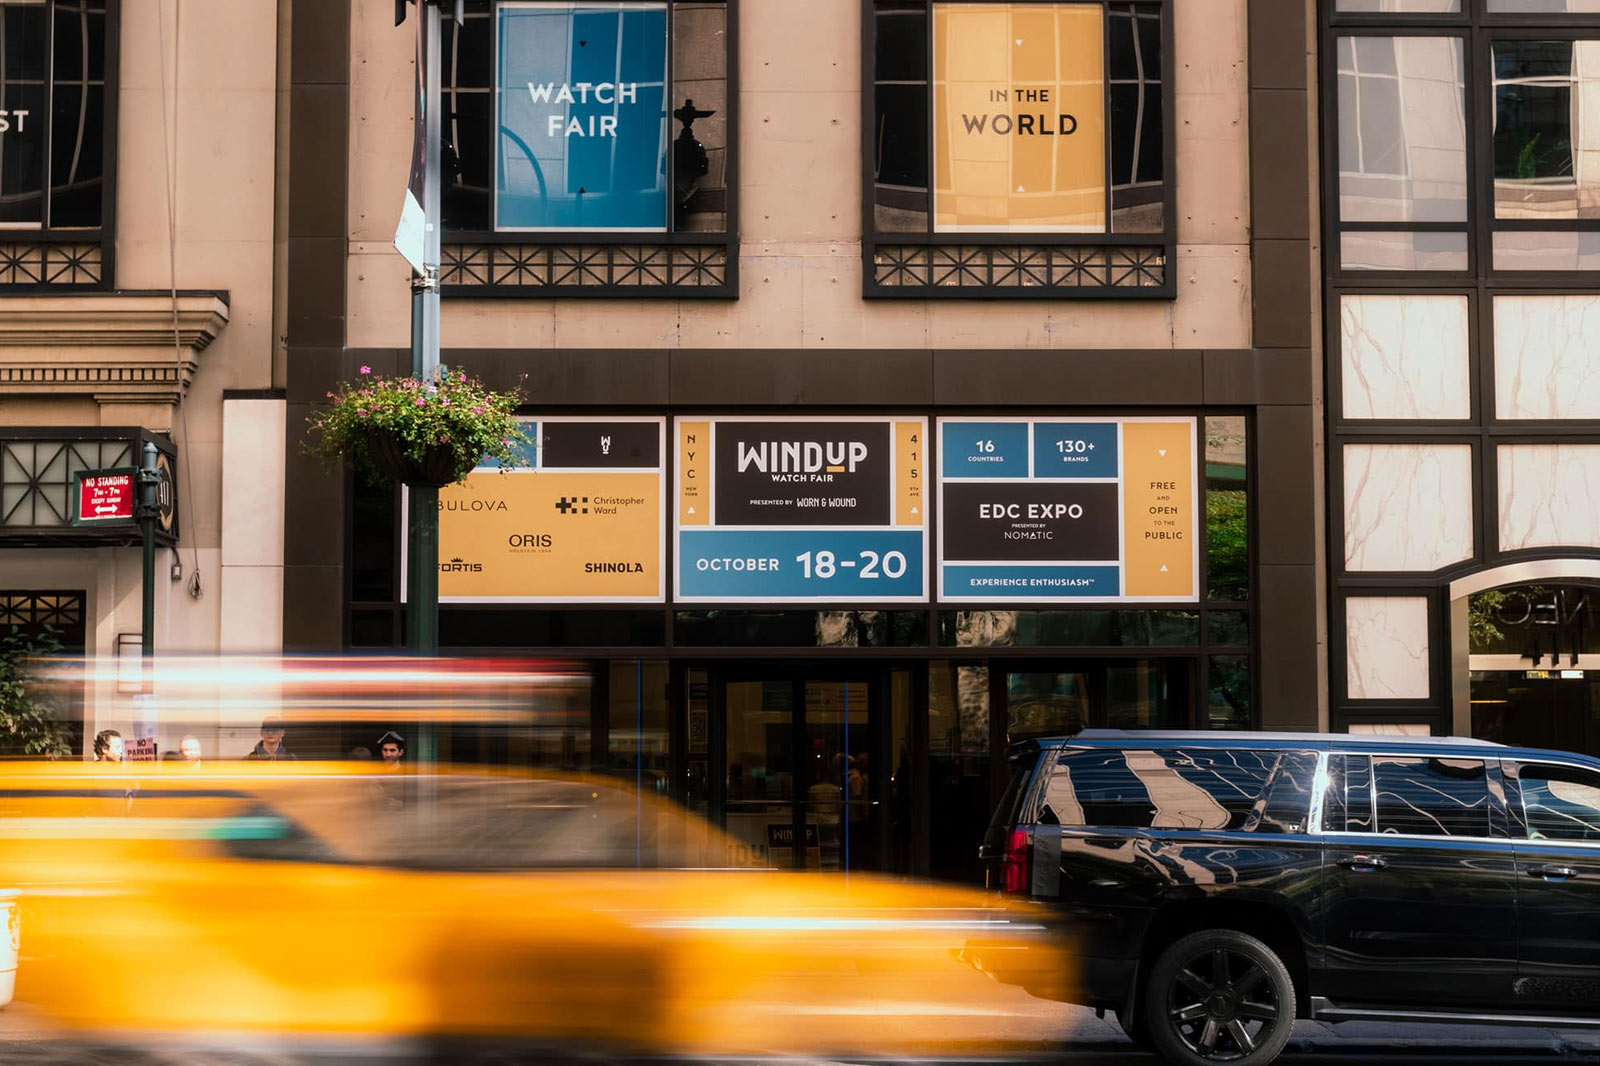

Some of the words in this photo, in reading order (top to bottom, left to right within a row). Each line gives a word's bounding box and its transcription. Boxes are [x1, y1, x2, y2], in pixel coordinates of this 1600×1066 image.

[527, 82, 638, 105] WATCH
[989, 89, 1008, 103] IN
[1014, 89, 1049, 103] THE
[547, 115, 619, 138] FAIR
[962, 114, 1078, 136] WORLD
[976, 440, 995, 453] 16
[1056, 440, 1095, 453] 130+
[737, 441, 868, 473] WINDUP
[85, 478, 95, 487] NO
[98, 476, 129, 487] STANDING
[771, 474, 807, 483] WATCH
[810, 474, 834, 483] FAIR
[1150, 481, 1176, 490] FREE
[593, 496, 645, 507] Christopher
[796, 497, 820, 508] WORN
[821, 497, 827, 508] &
[828, 497, 857, 508] WOUND
[593, 506, 617, 515] Ward
[979, 503, 1021, 519] EDC
[1027, 503, 1083, 519] EXPO
[1148, 506, 1178, 515] OPEN
[508, 534, 552, 548] ORIS
[1005, 531, 1053, 540] NOMATIC
[1144, 531, 1183, 540] PUBLIC
[584, 562, 644, 574] SHINOLA
[696, 558, 780, 571] OCTOBER
[796, 550, 907, 579] 18-20
[970, 578, 1028, 586] EXPERIENCE
[137, 739, 147, 747] NO
